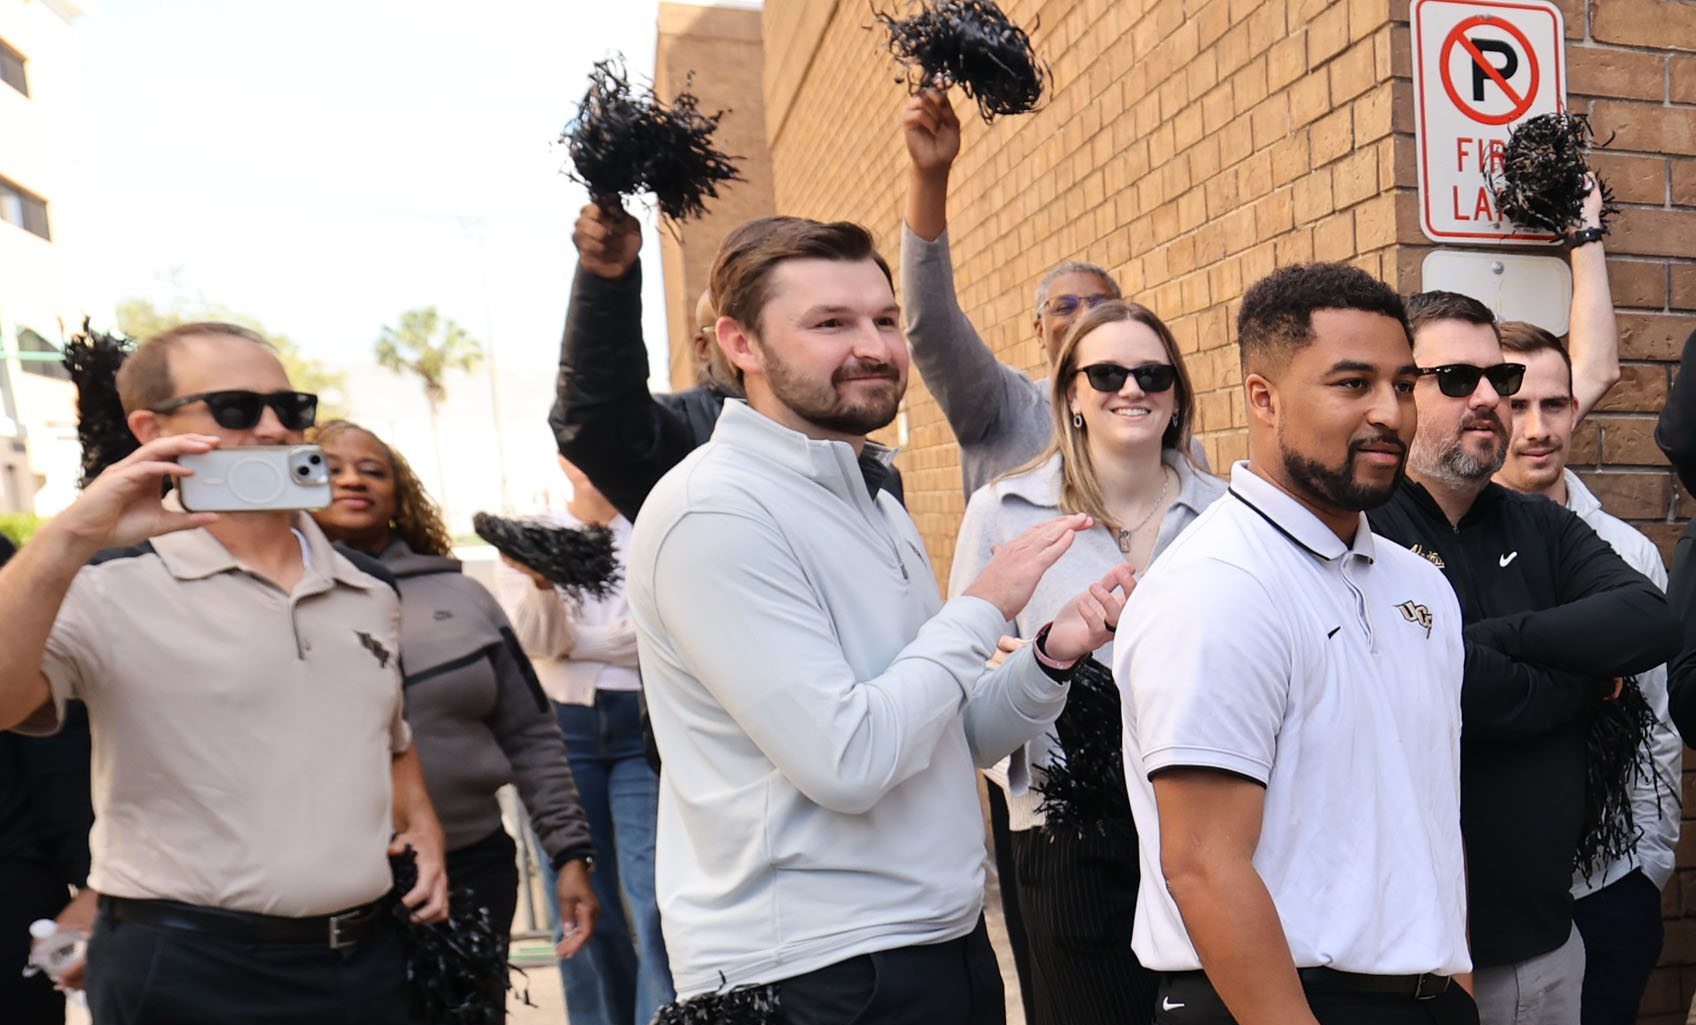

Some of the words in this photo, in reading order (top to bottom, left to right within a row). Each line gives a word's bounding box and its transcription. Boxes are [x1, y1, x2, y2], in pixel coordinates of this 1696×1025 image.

[1471, 38, 1518, 101] P
[1457, 137, 1507, 173] FIR
[1453, 185, 1503, 221] LA
